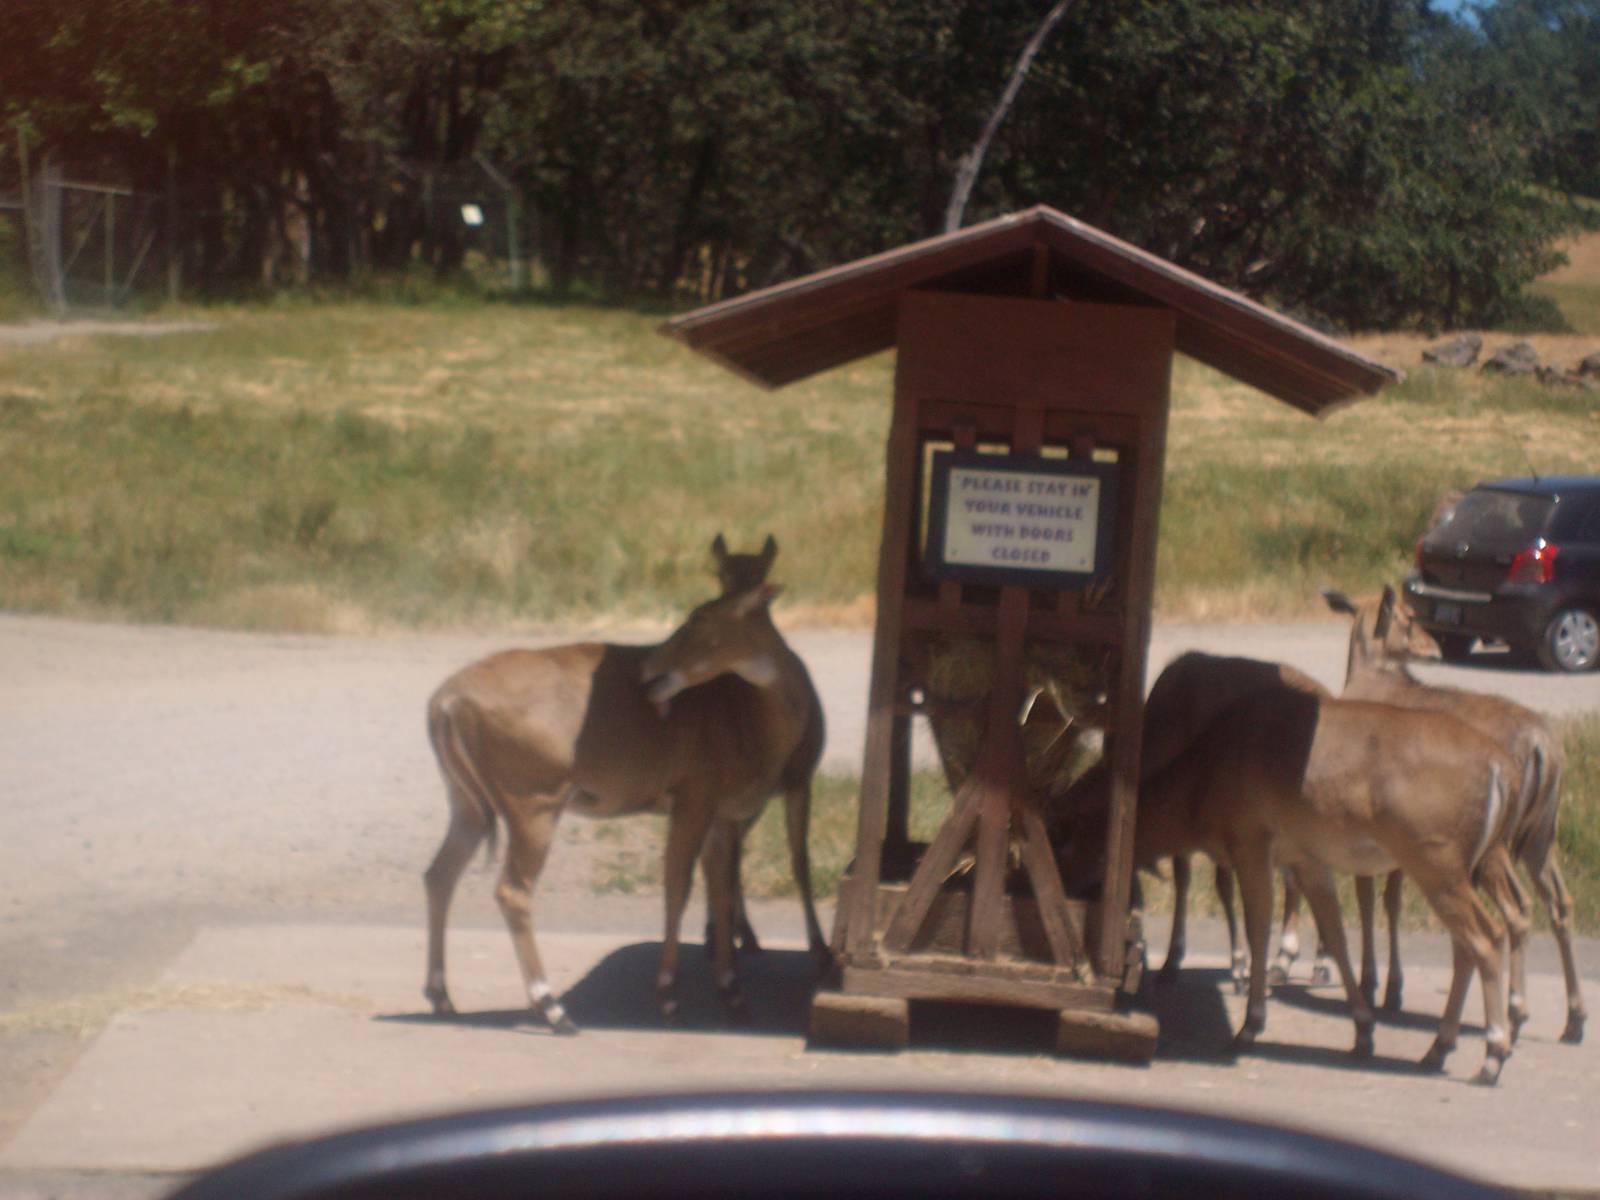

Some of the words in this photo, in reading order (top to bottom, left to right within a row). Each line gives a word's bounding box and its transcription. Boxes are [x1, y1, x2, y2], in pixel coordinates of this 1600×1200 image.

[961, 476, 1021, 493] PLEASE
[1027, 479, 1068, 496] STAY
[1071, 482, 1090, 497] IN
[965, 500, 1011, 515] YOUR
[1016, 503, 1083, 520] VEHICLE
[971, 523, 1015, 538] WITH
[1020, 526, 1074, 542] DOORS
[991, 547, 1052, 563] CLOSED
